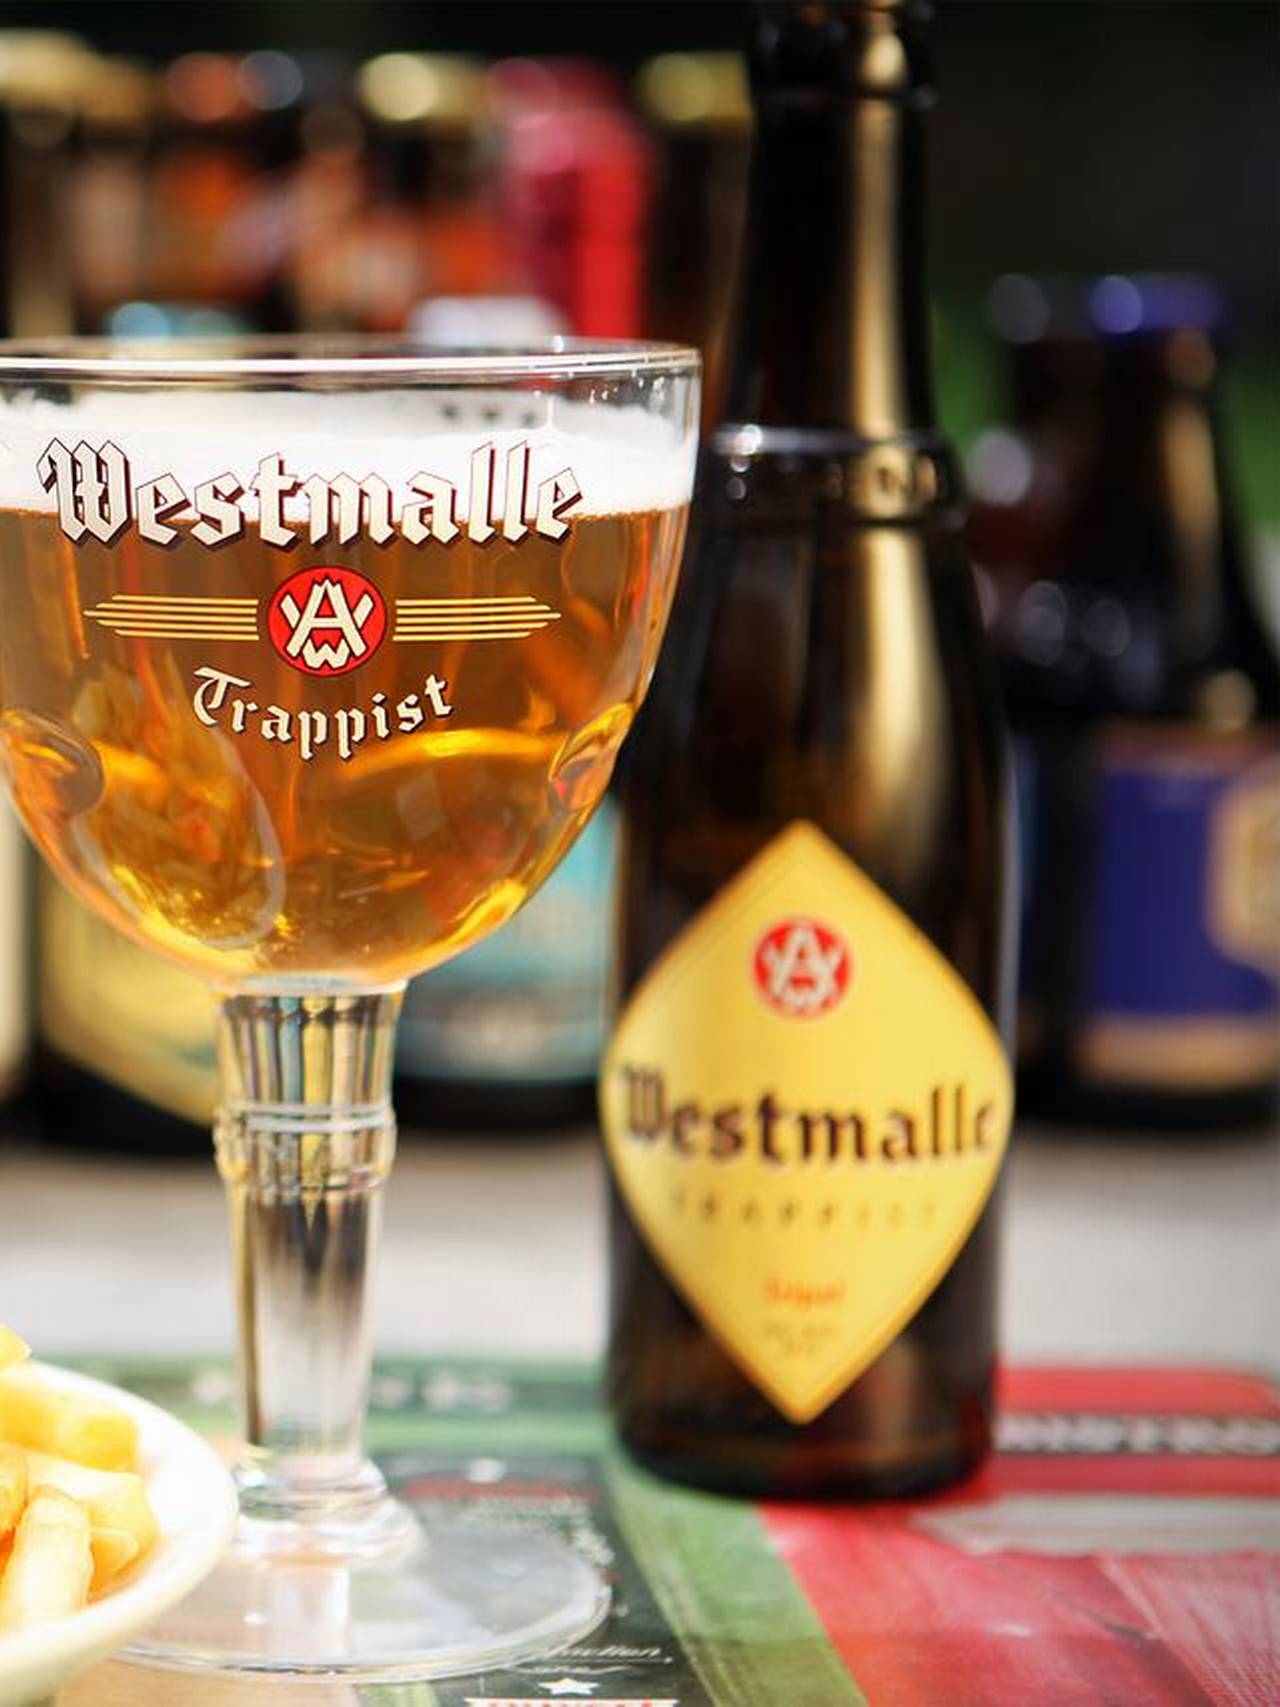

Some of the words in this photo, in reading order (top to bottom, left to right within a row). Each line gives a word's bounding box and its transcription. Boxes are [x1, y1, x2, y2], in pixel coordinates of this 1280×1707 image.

[36, 437, 585, 550] Westmalle
[192, 666, 454, 760] Trappist
[622, 1063, 995, 1166] Westmalle
